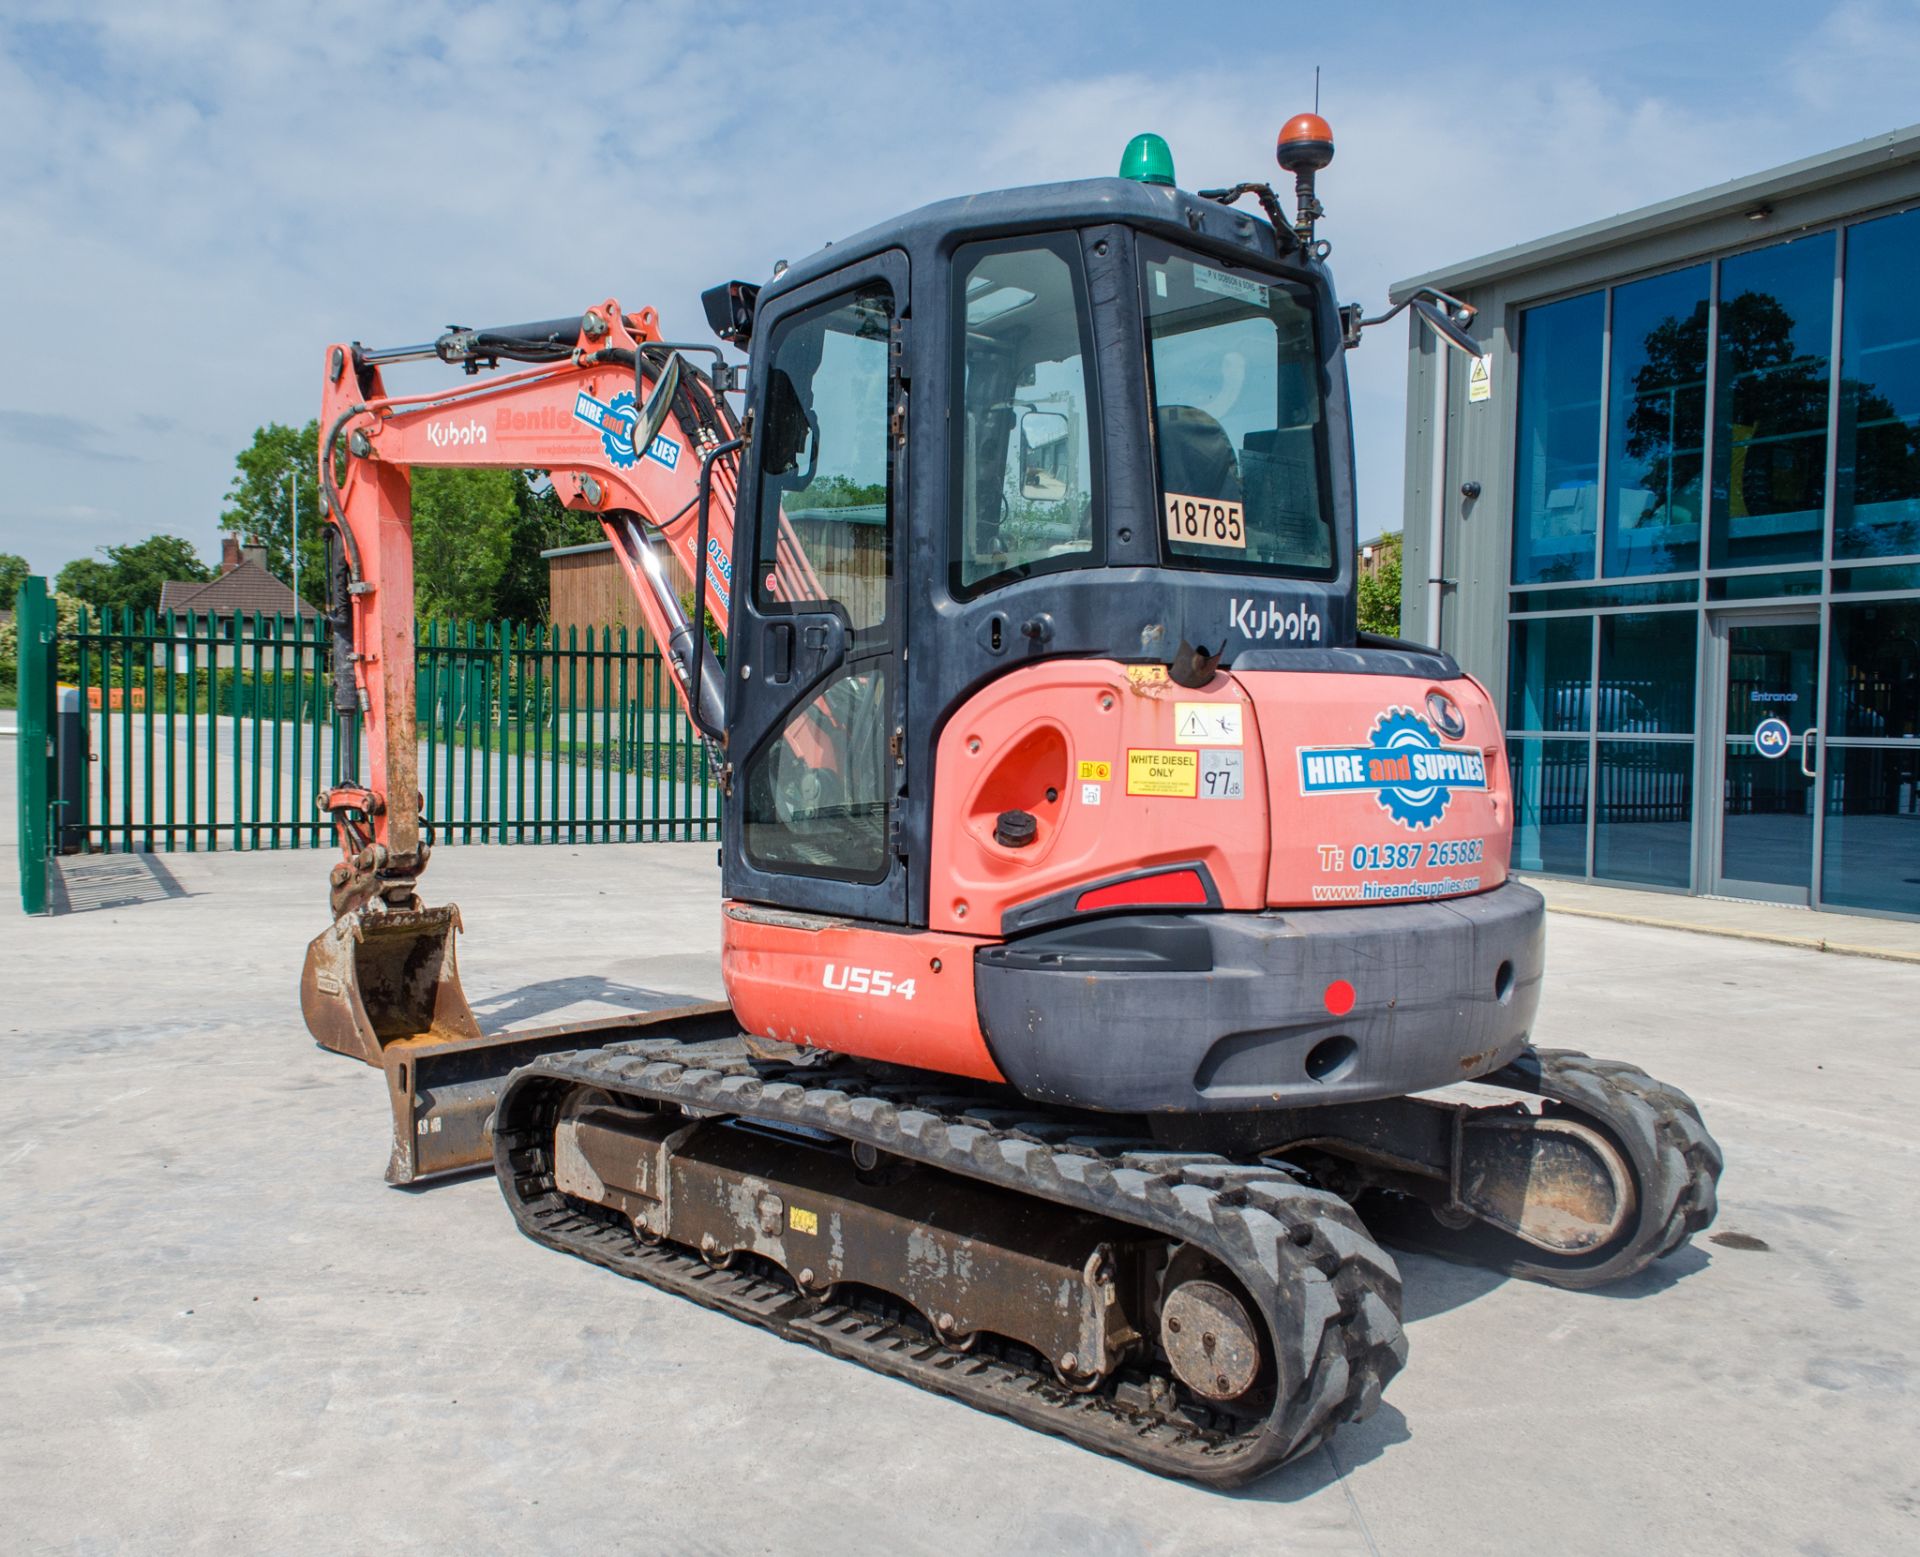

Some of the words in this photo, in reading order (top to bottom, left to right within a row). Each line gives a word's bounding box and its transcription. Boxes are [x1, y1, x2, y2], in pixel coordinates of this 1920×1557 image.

[427, 419, 487, 447] Kubota
[577, 397, 603, 424] HIRE
[602, 413, 625, 436] and
[624, 422, 677, 465] SLIES
[1169, 499, 1241, 541] 18785
[1230, 598, 1321, 641] Kubota
[1751, 691, 1799, 702] Entrance
[1760, 731, 1783, 746] GA
[1131, 755, 1160, 765] WHITE
[1162, 756, 1194, 766] DIESEL
[1149, 768, 1175, 778] ONLY
[1307, 755, 1365, 784] HIRE
[1368, 754, 1411, 782] and
[1413, 753, 1483, 782] SUPPLIES
[1204, 771, 1231, 795] 97
[1318, 845, 1345, 871] T:
[1351, 842, 1423, 871] 01387
[1426, 839, 1485, 868] 265882
[1312, 877, 1481, 901] www.hireandsupplies.com
